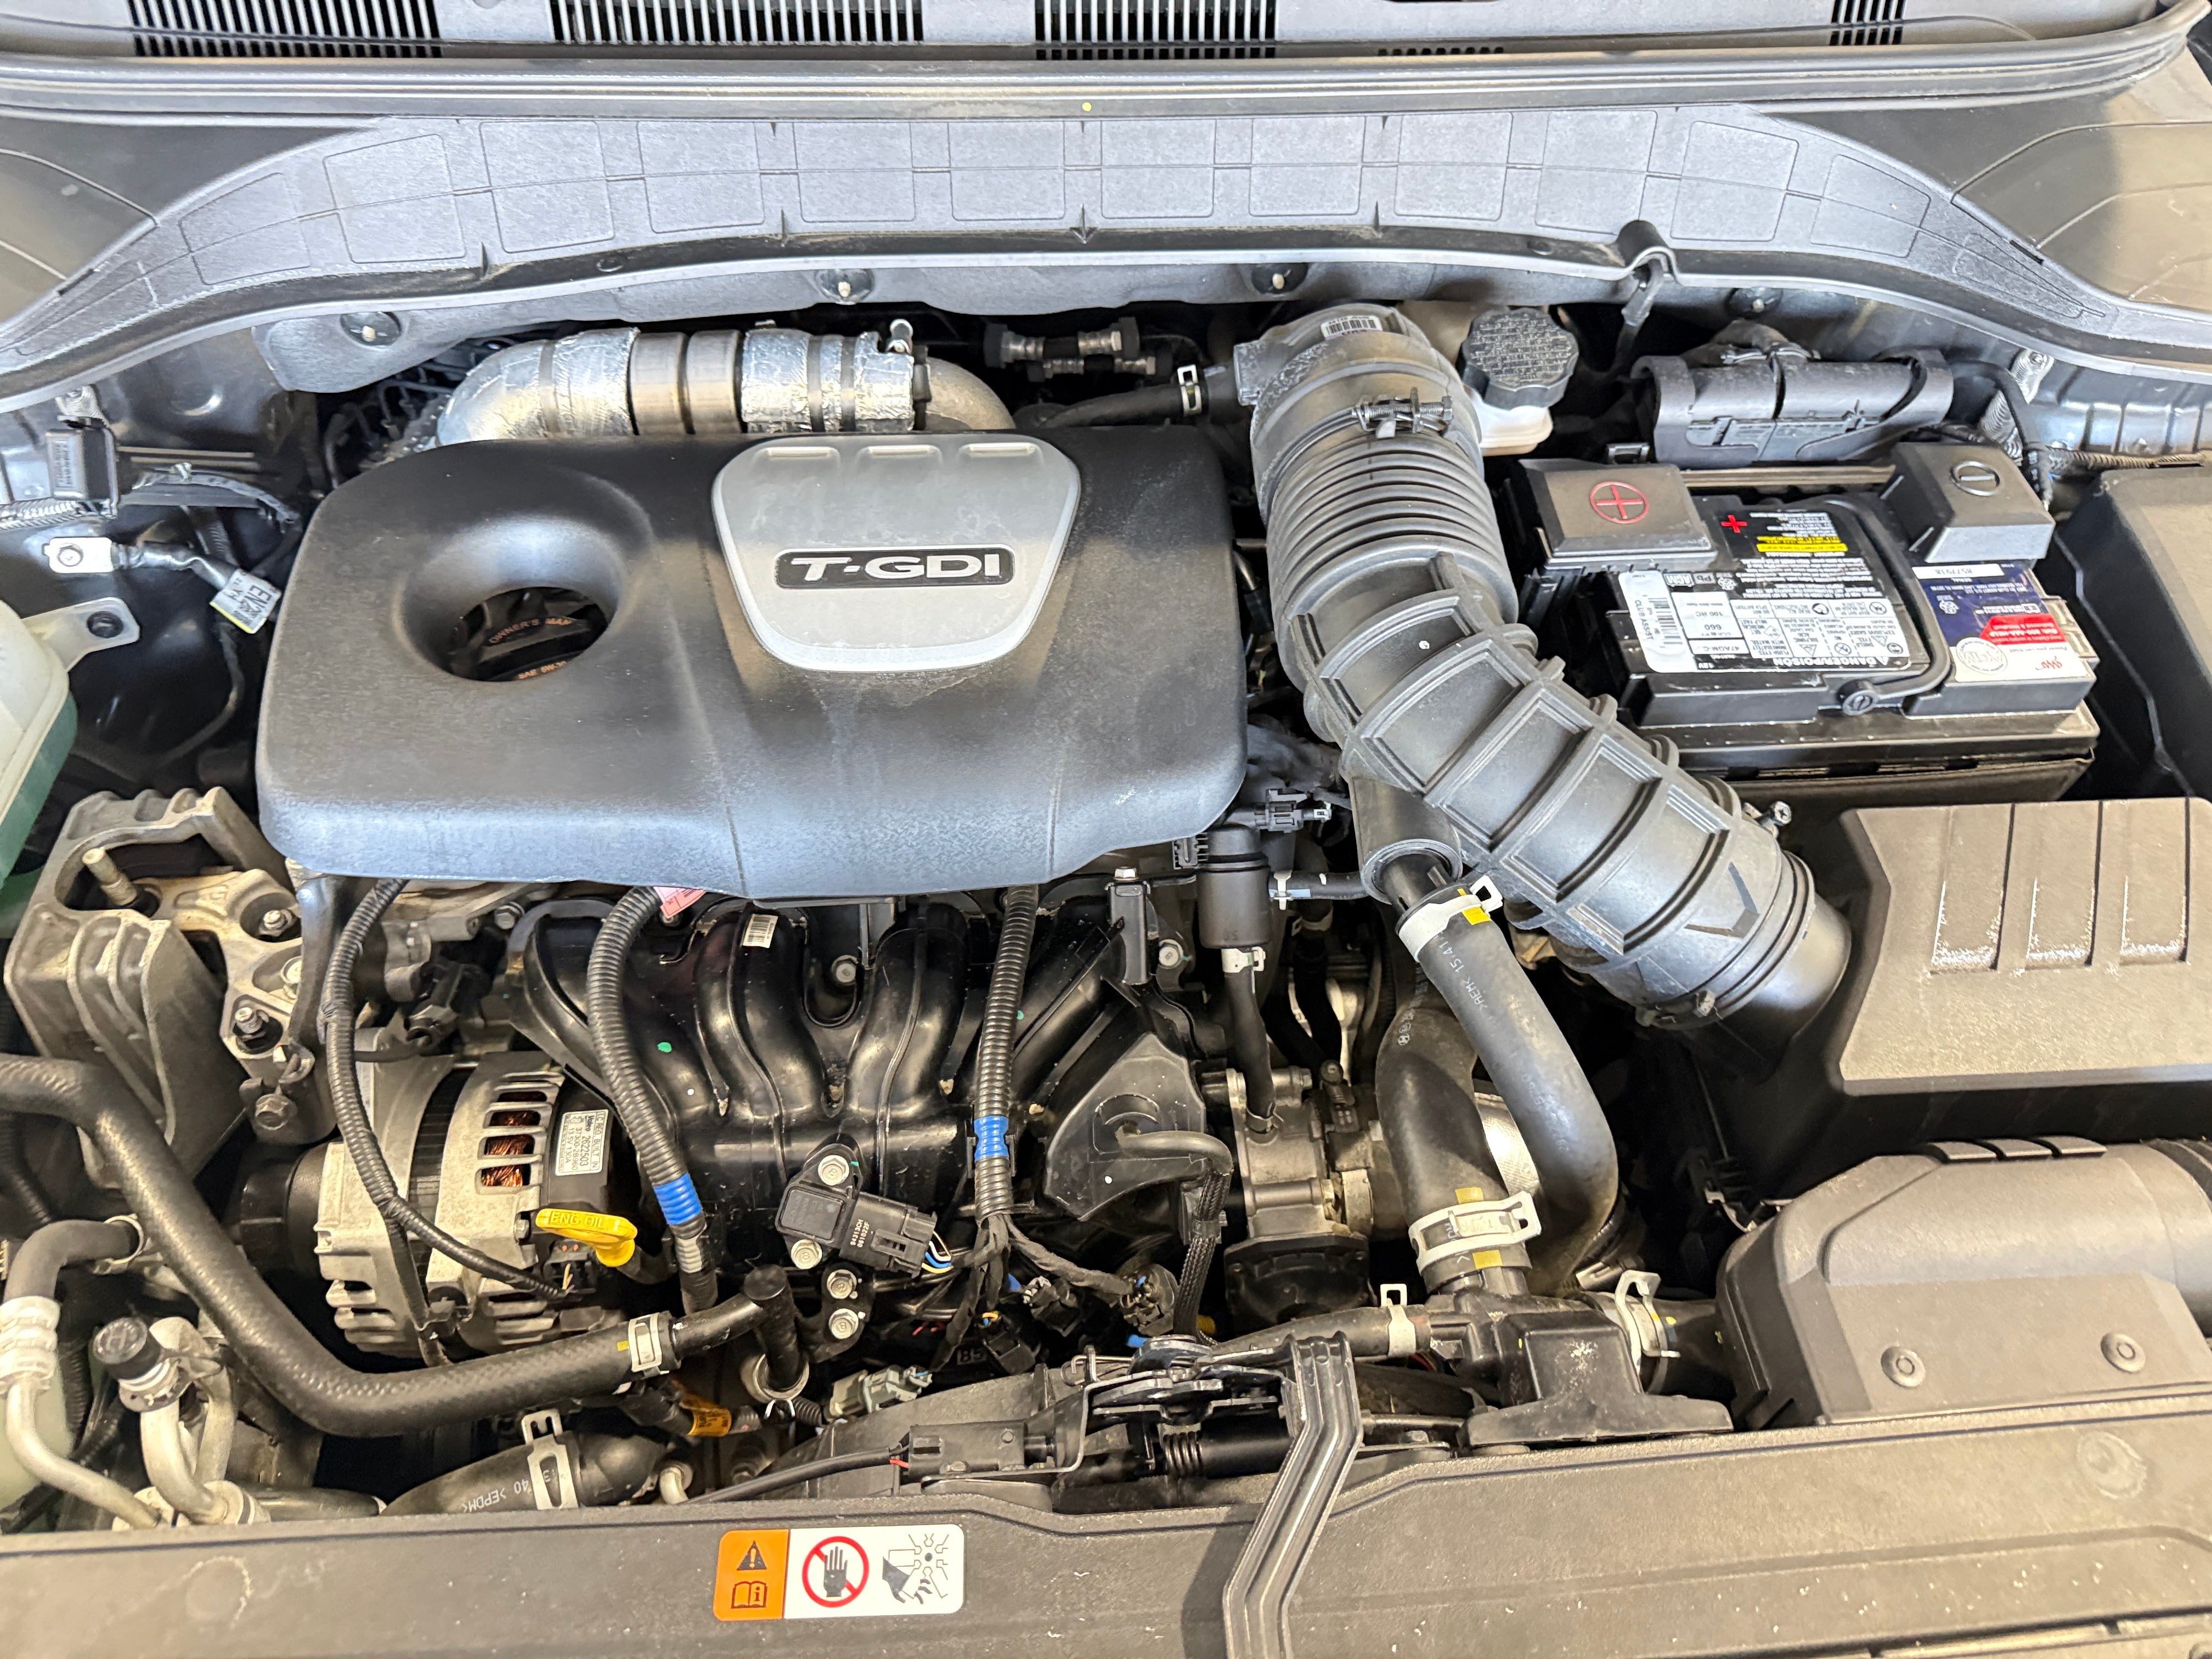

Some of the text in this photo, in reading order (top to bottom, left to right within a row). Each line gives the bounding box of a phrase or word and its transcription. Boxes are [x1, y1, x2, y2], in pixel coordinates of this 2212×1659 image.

[792, 554, 1000, 582] T-GDI
[489, 618, 540, 644] OWNER'S
[1634, 600, 1654, 640] CLUB ASSIST
[580, 1136, 591, 1166] 2622503
[592, 1139, 601, 1157] BUILT
[550, 1211, 603, 1228] ENG OIL
[461, 1487, 506, 1513] >EPDM<
